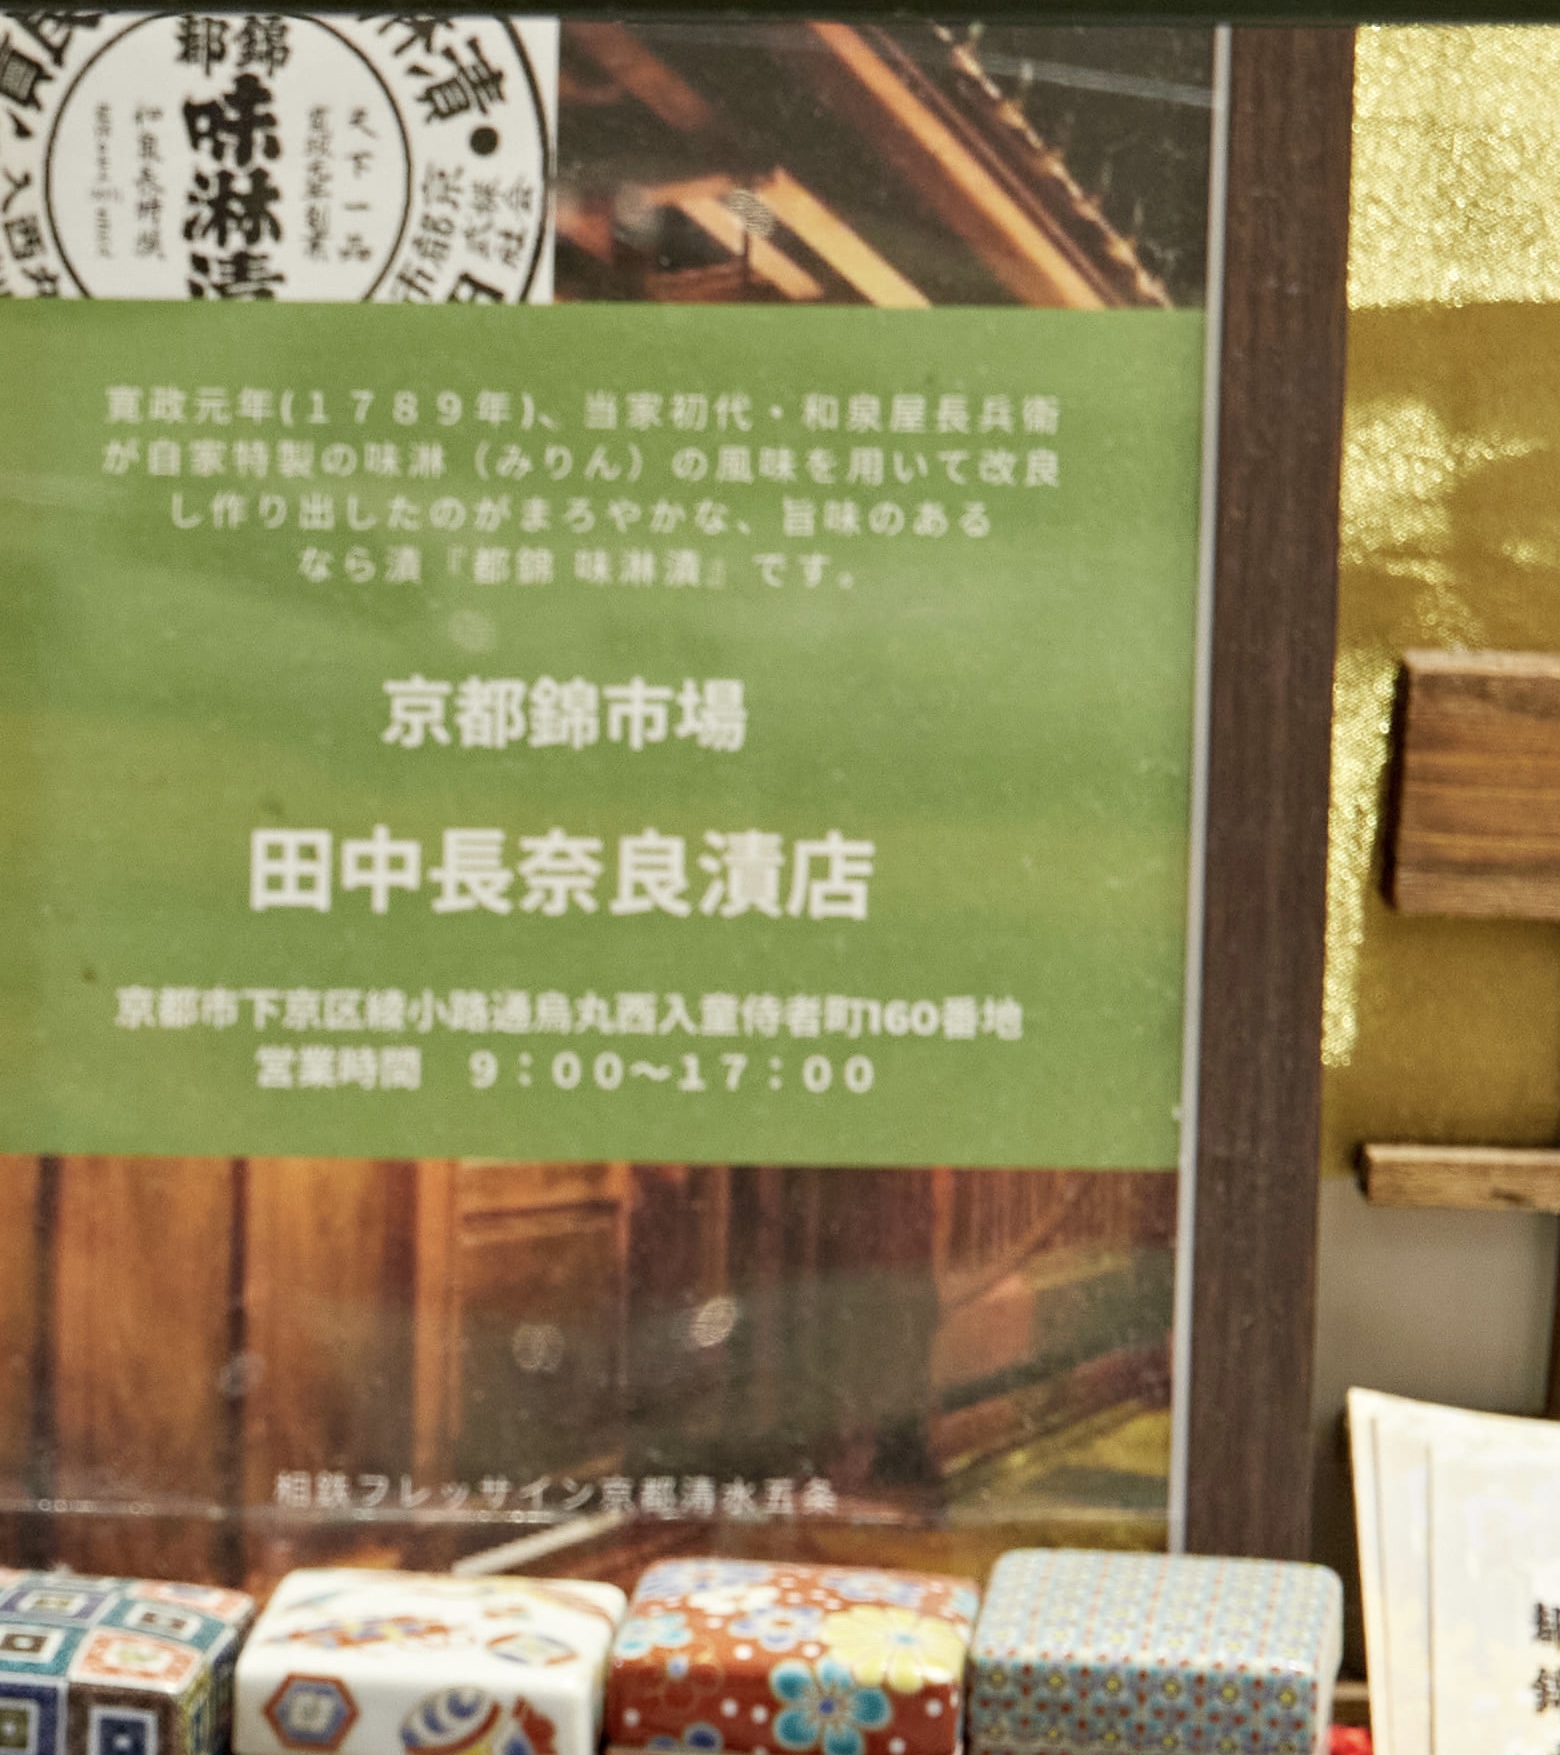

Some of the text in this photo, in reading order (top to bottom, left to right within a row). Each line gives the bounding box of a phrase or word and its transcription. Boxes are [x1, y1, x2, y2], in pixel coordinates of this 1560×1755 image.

[170, 491, 991, 538] し作り出したのがまろやかな、旨味のある
[381, 674, 749, 752] 京都錦市場
[249, 824, 877, 920] 田中長奈良漬店
[255, 1044, 423, 1091] 営業時間
